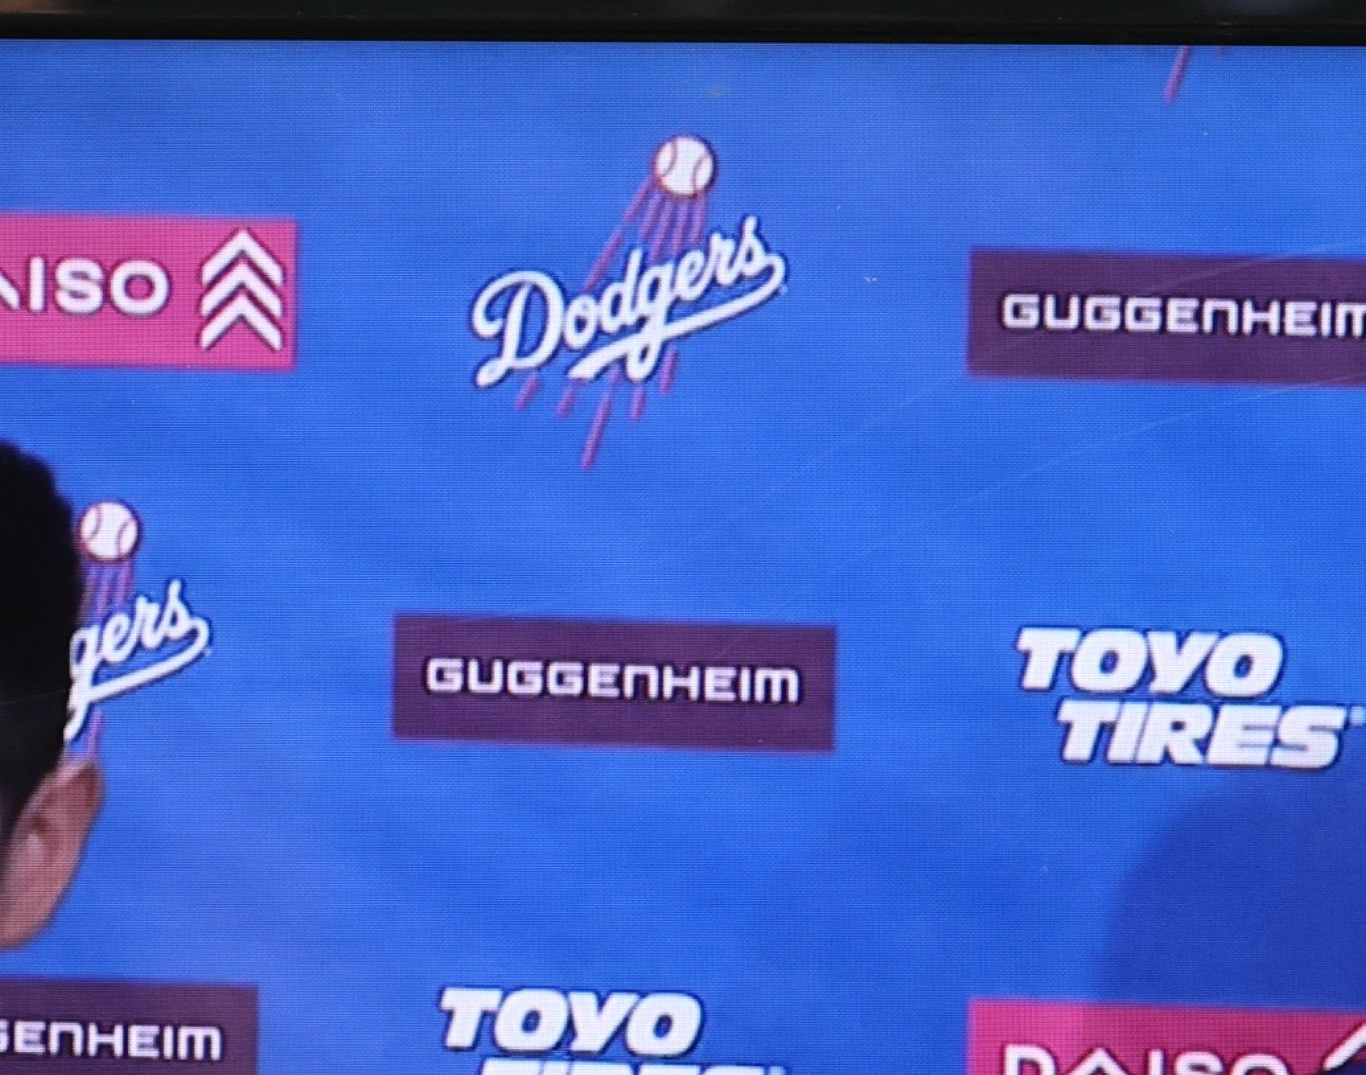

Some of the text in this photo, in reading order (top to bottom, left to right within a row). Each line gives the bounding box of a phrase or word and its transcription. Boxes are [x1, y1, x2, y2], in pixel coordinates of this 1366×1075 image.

[473, 216, 785, 386] Dodgers
[64, 580, 209, 740] gers
[427, 658, 799, 702] GUGGENHEIM
[1016, 627, 1284, 697] TOYO
[439, 987, 703, 1058] TOYO
